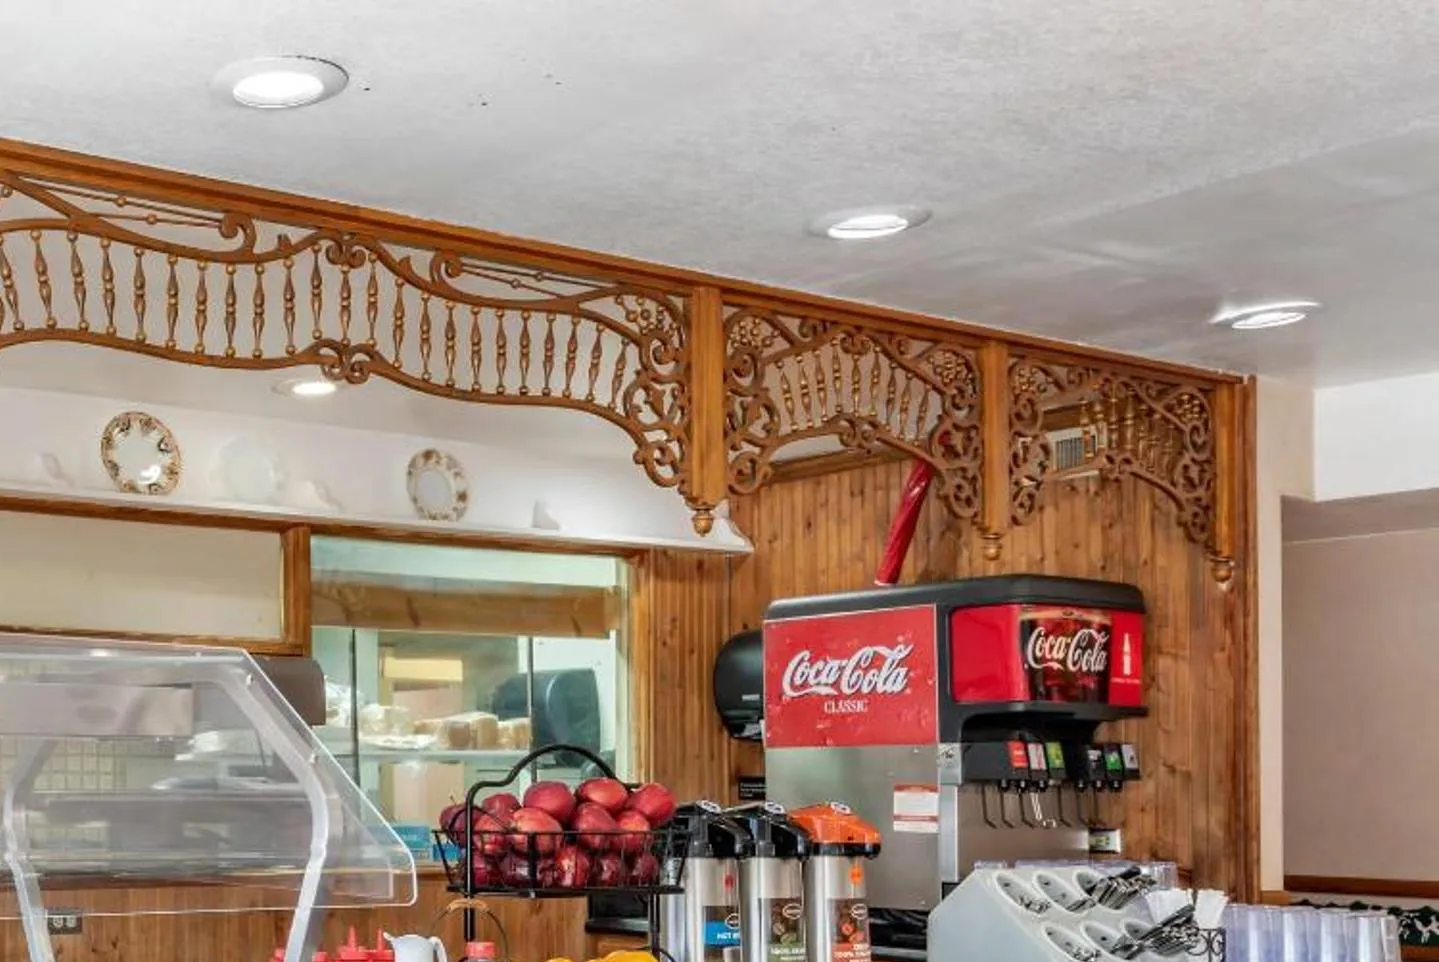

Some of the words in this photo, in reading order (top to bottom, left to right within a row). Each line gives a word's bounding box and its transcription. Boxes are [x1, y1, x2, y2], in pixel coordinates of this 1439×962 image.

[781, 642, 914, 699] Coca-Cola
[1025, 626, 1111, 674] Coca-Cola
[824, 699, 868, 714] CLASSIC
